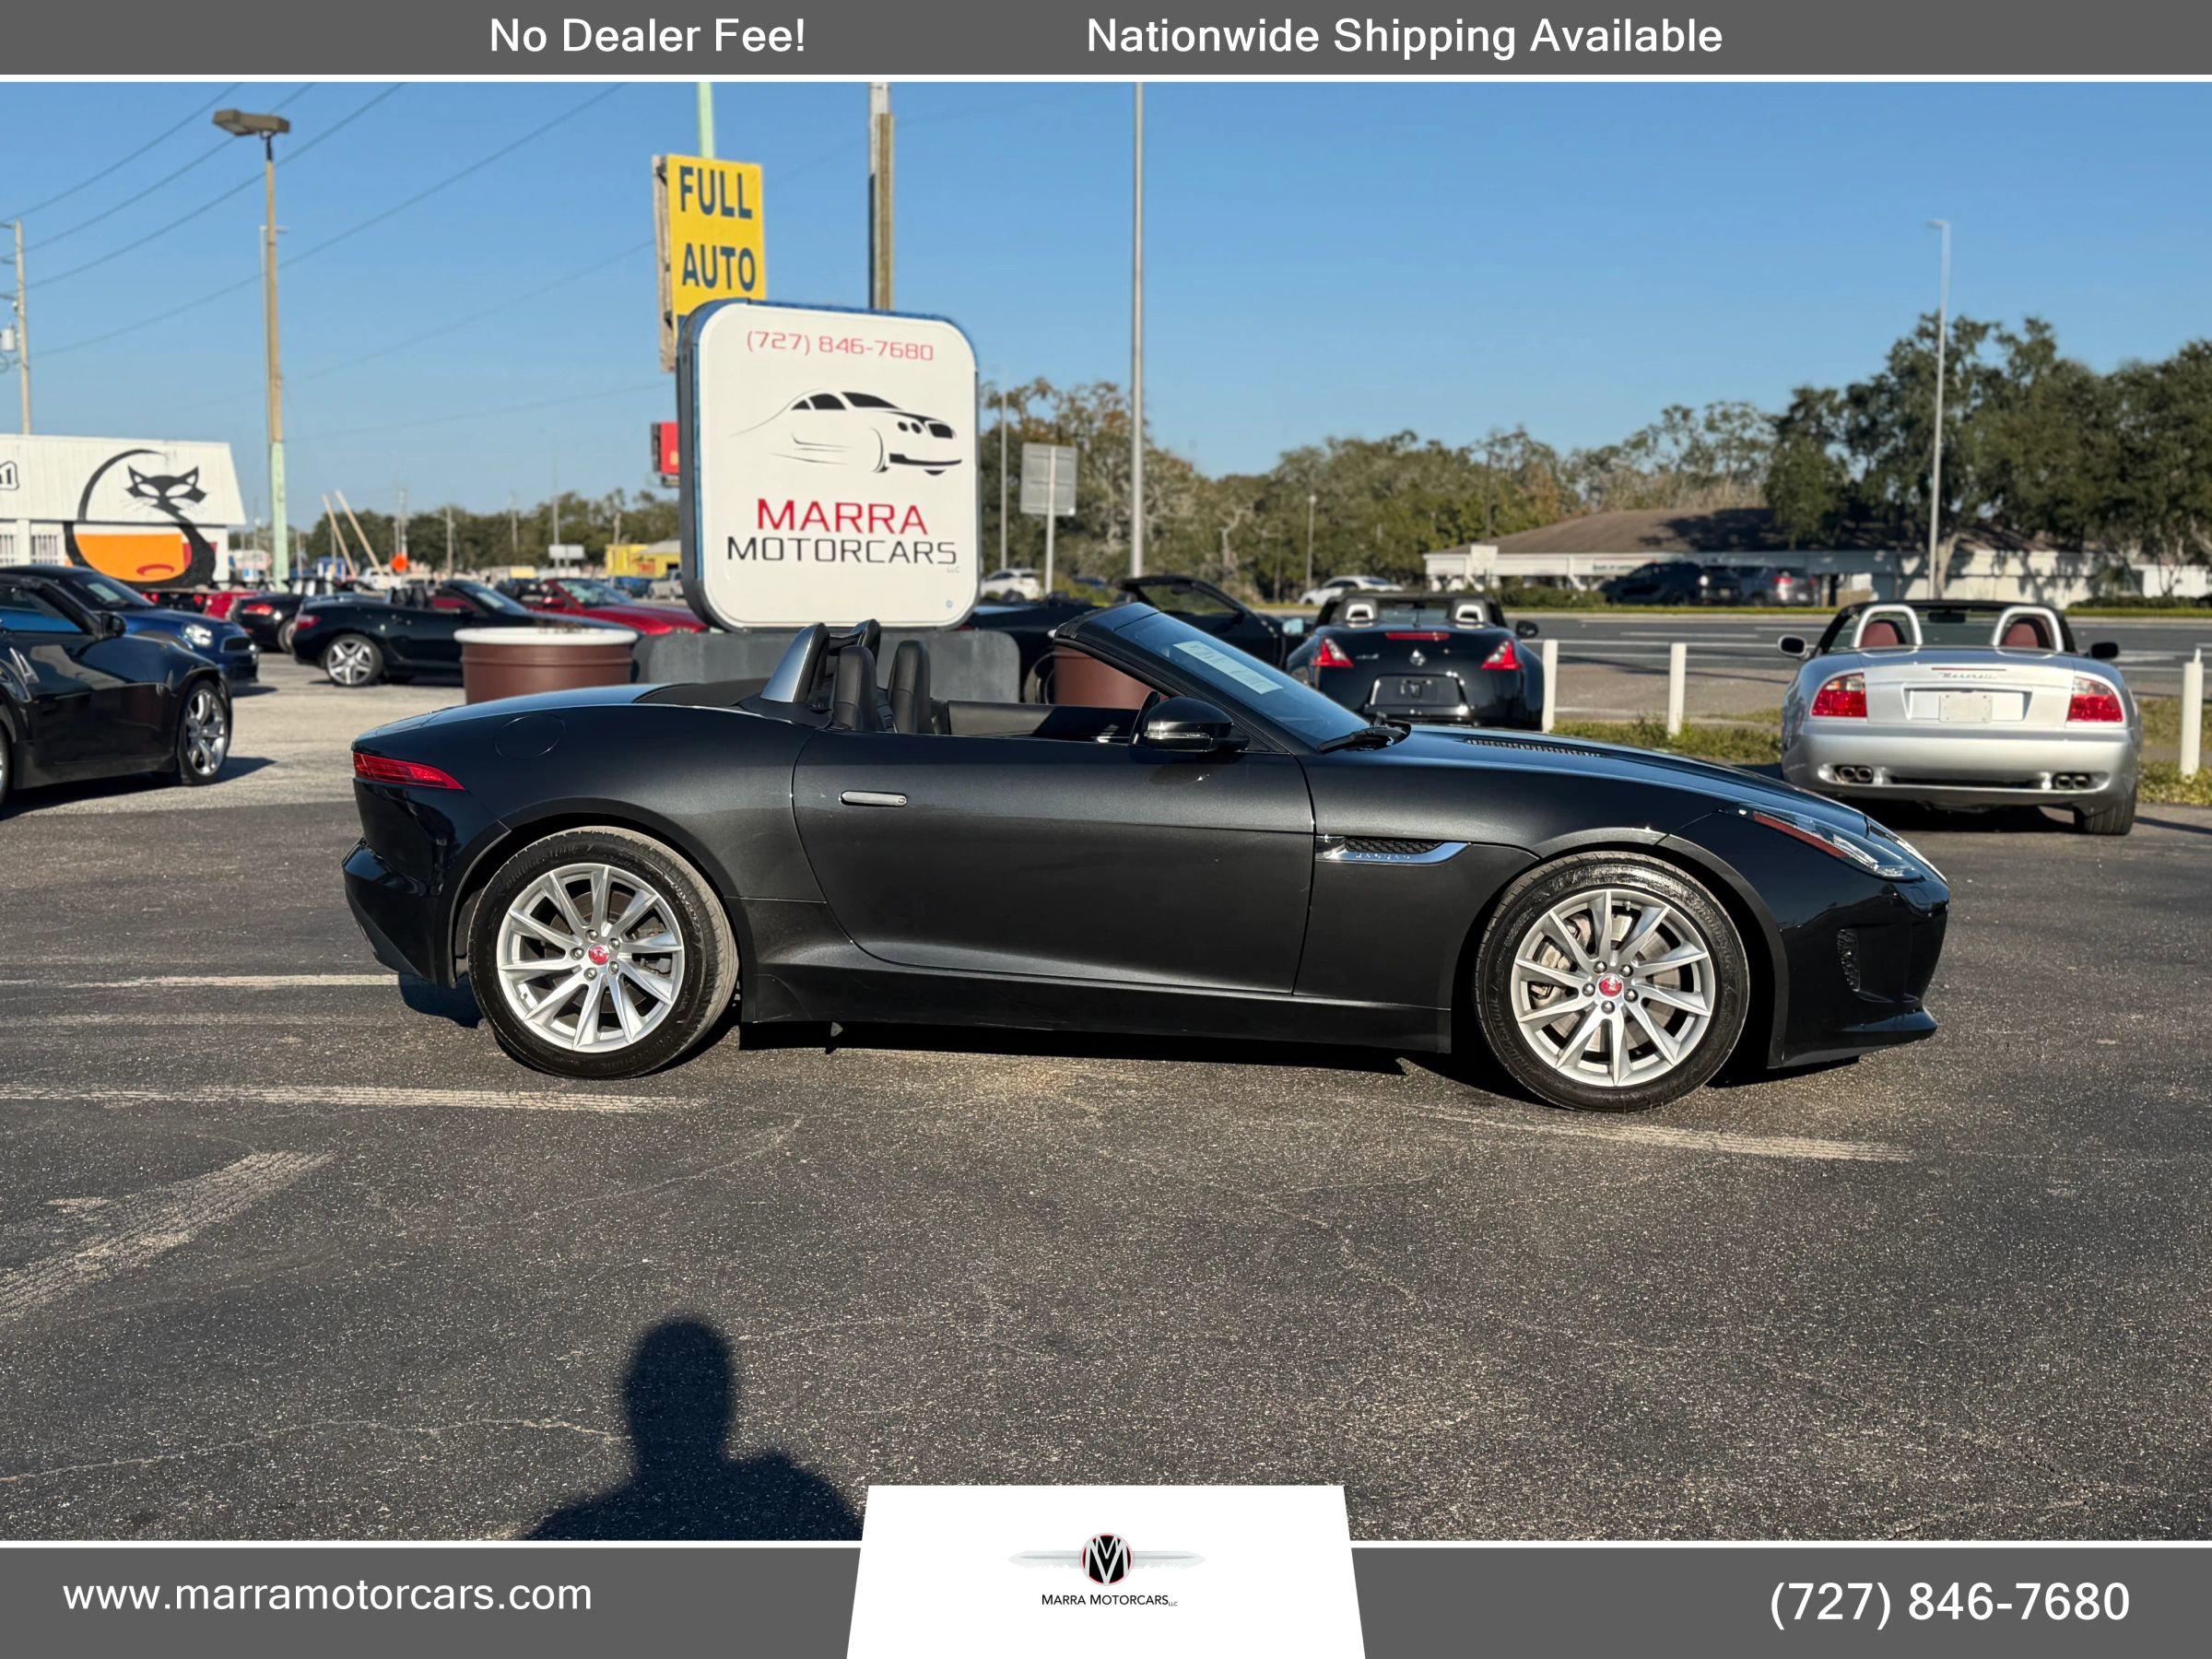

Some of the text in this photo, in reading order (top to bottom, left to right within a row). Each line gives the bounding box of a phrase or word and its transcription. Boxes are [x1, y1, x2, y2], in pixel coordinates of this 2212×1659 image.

[678, 164, 753, 219] FULL
[681, 241, 756, 292] AUTO
[746, 329, 935, 362] (727) 846-7680
[757, 497, 928, 535] MARRA
[726, 535, 958, 566] MOTORCARS
